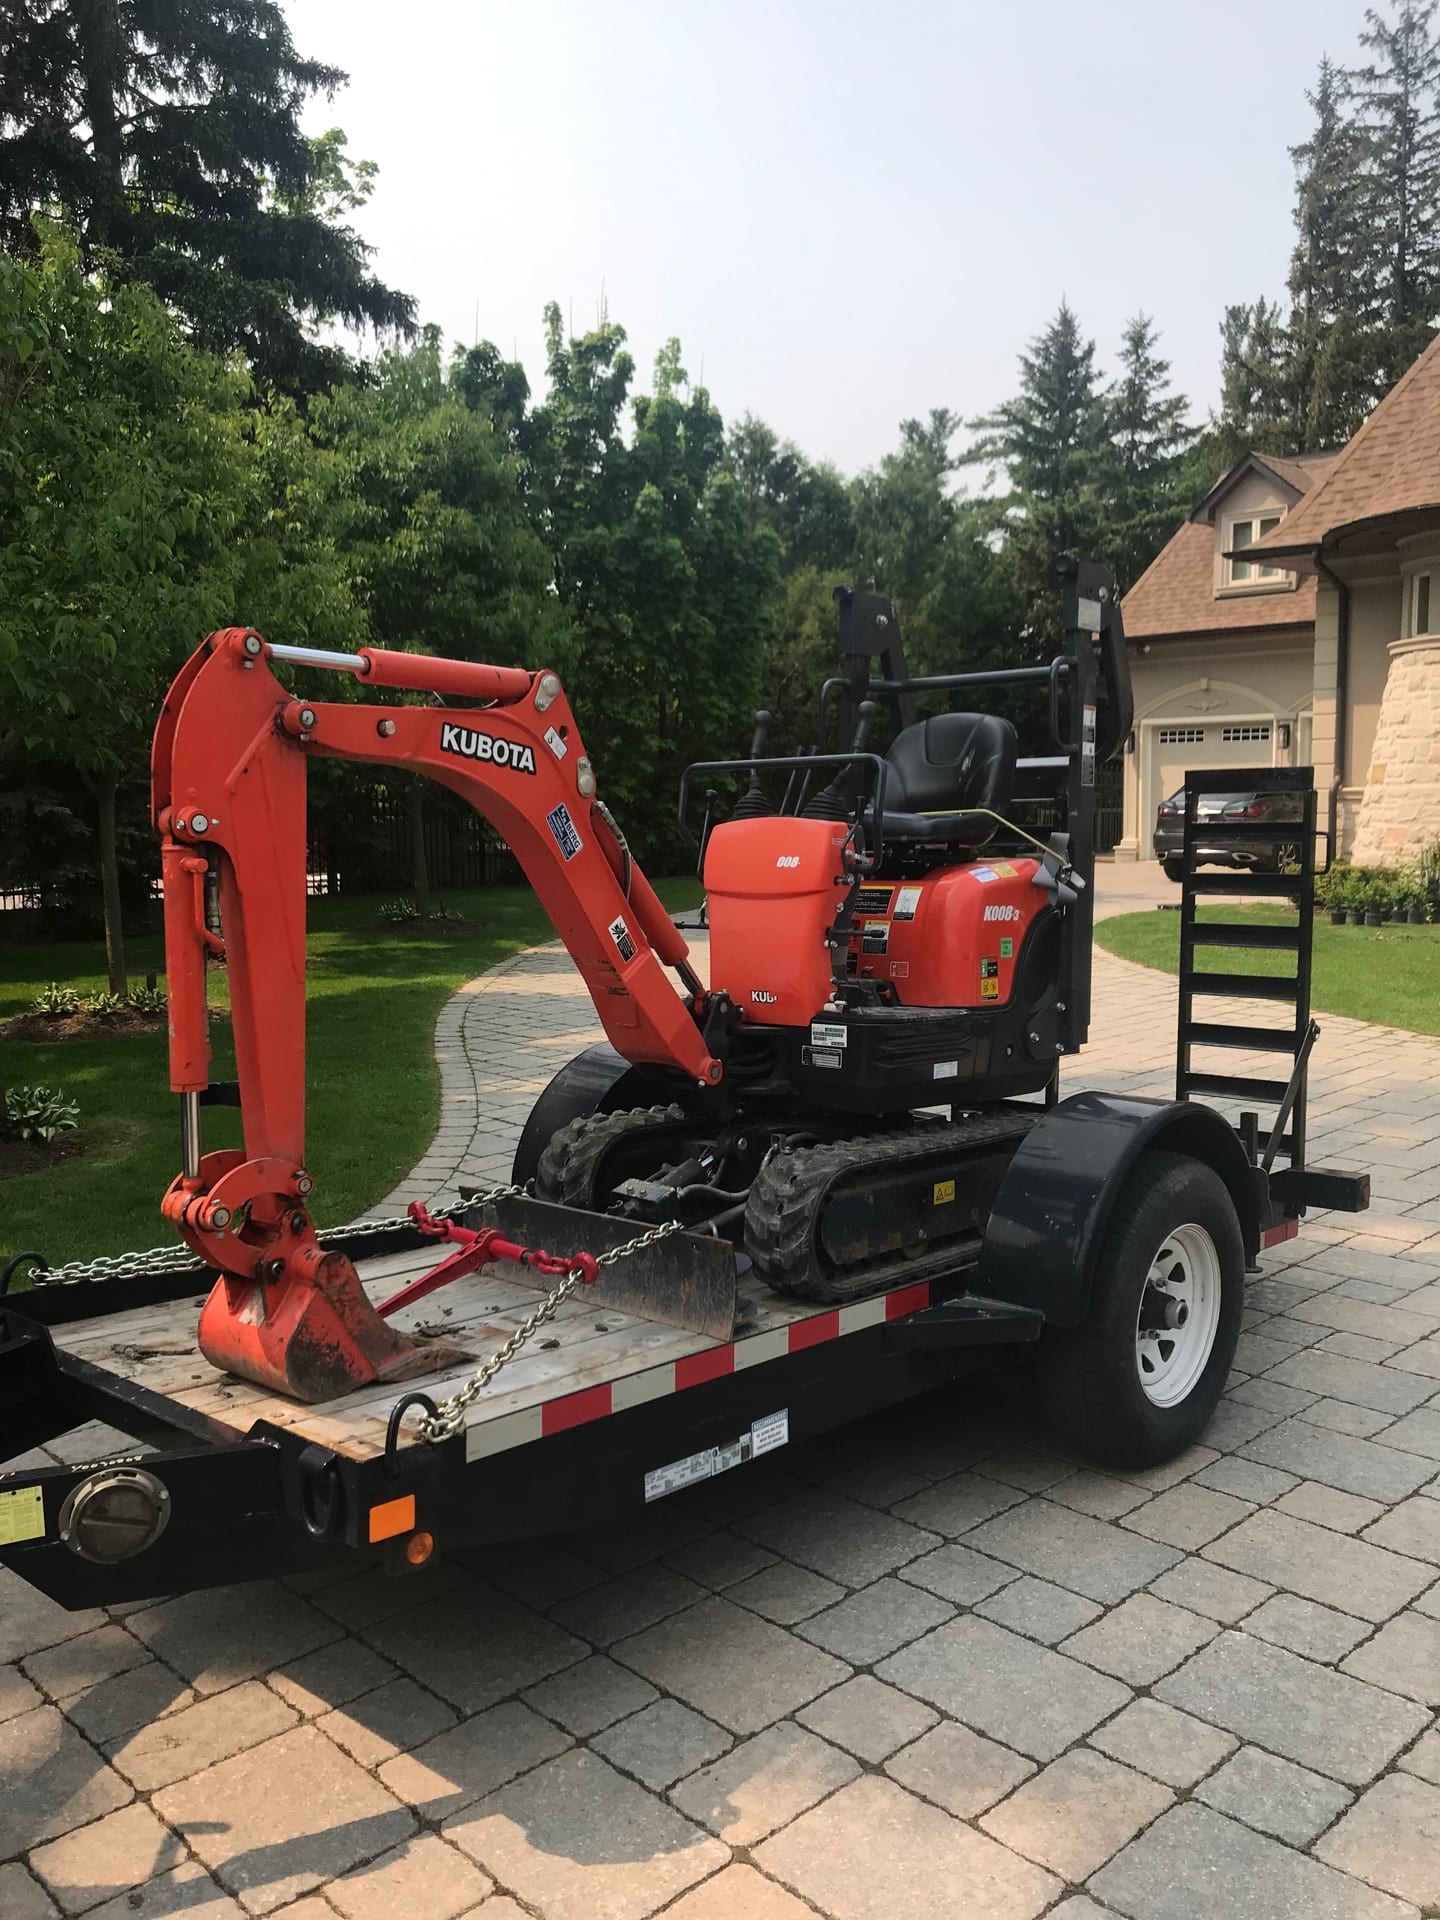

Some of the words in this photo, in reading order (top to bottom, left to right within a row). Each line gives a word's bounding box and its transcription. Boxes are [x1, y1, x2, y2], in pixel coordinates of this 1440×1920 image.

[441, 723, 535, 773] KUBOTA
[566, 822, 581, 849] BERG
[983, 904, 1020, 921] K008-3
